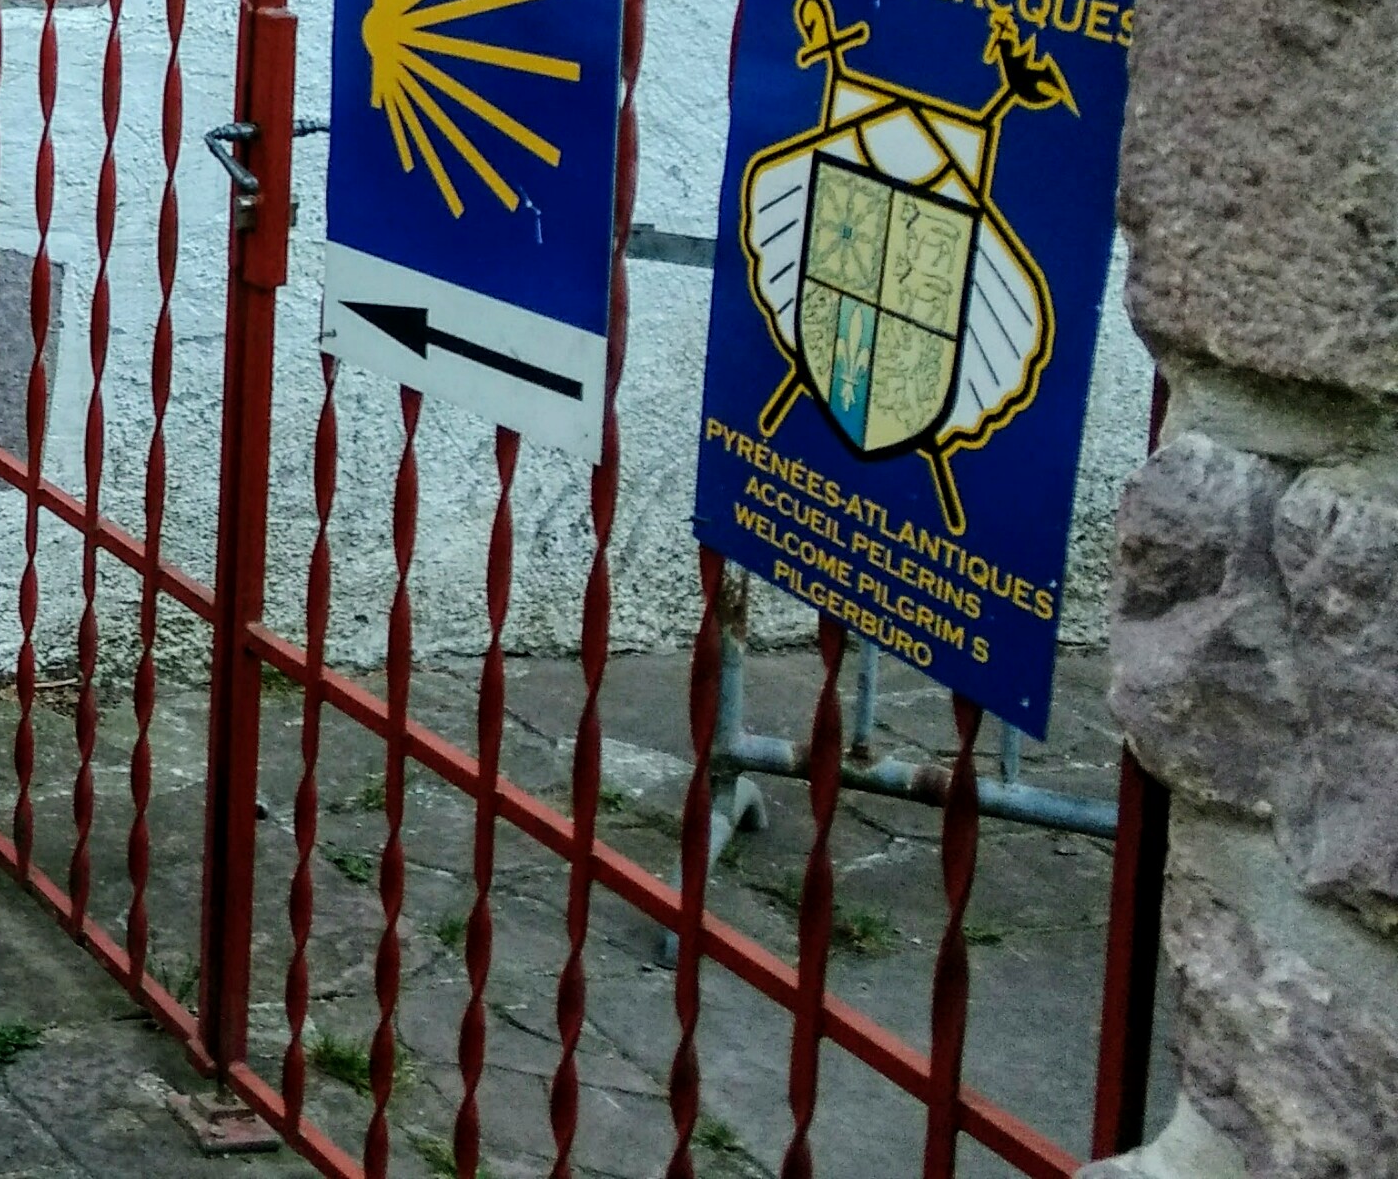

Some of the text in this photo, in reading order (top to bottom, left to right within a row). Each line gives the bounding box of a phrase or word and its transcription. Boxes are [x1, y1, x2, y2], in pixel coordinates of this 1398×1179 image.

[705, 417, 1055, 621] PYRÉNÉES-ATLANTIQUES
[733, 501, 854, 587] WELCOME
[856, 572, 966, 651] PILGRIM
[744, 476, 981, 621] ACCUEIL PELERINS
[773, 559, 933, 668] PILGERBÜRO
